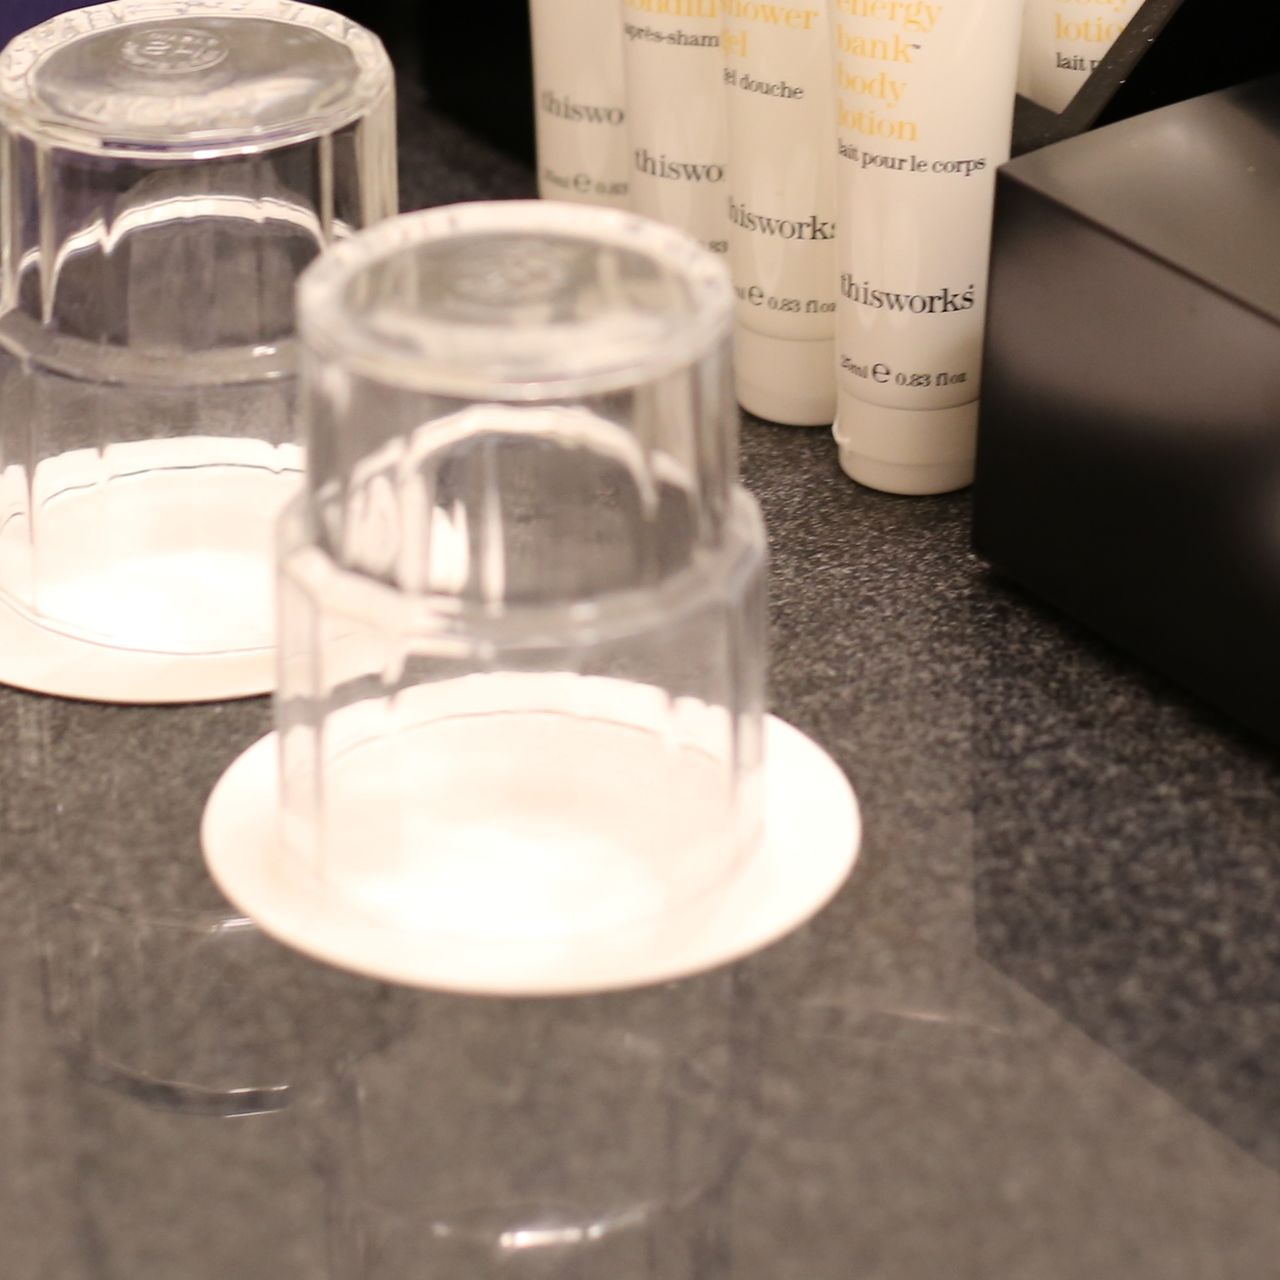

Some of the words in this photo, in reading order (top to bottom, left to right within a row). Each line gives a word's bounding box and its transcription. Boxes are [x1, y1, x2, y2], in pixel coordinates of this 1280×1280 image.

[1056, 52, 1086, 71] lait
[739, 73, 805, 100] douche
[836, 60, 907, 109] body
[861, 151, 908, 171] pour
[910, 155, 927, 172] le
[931, 157, 987, 177] corps
